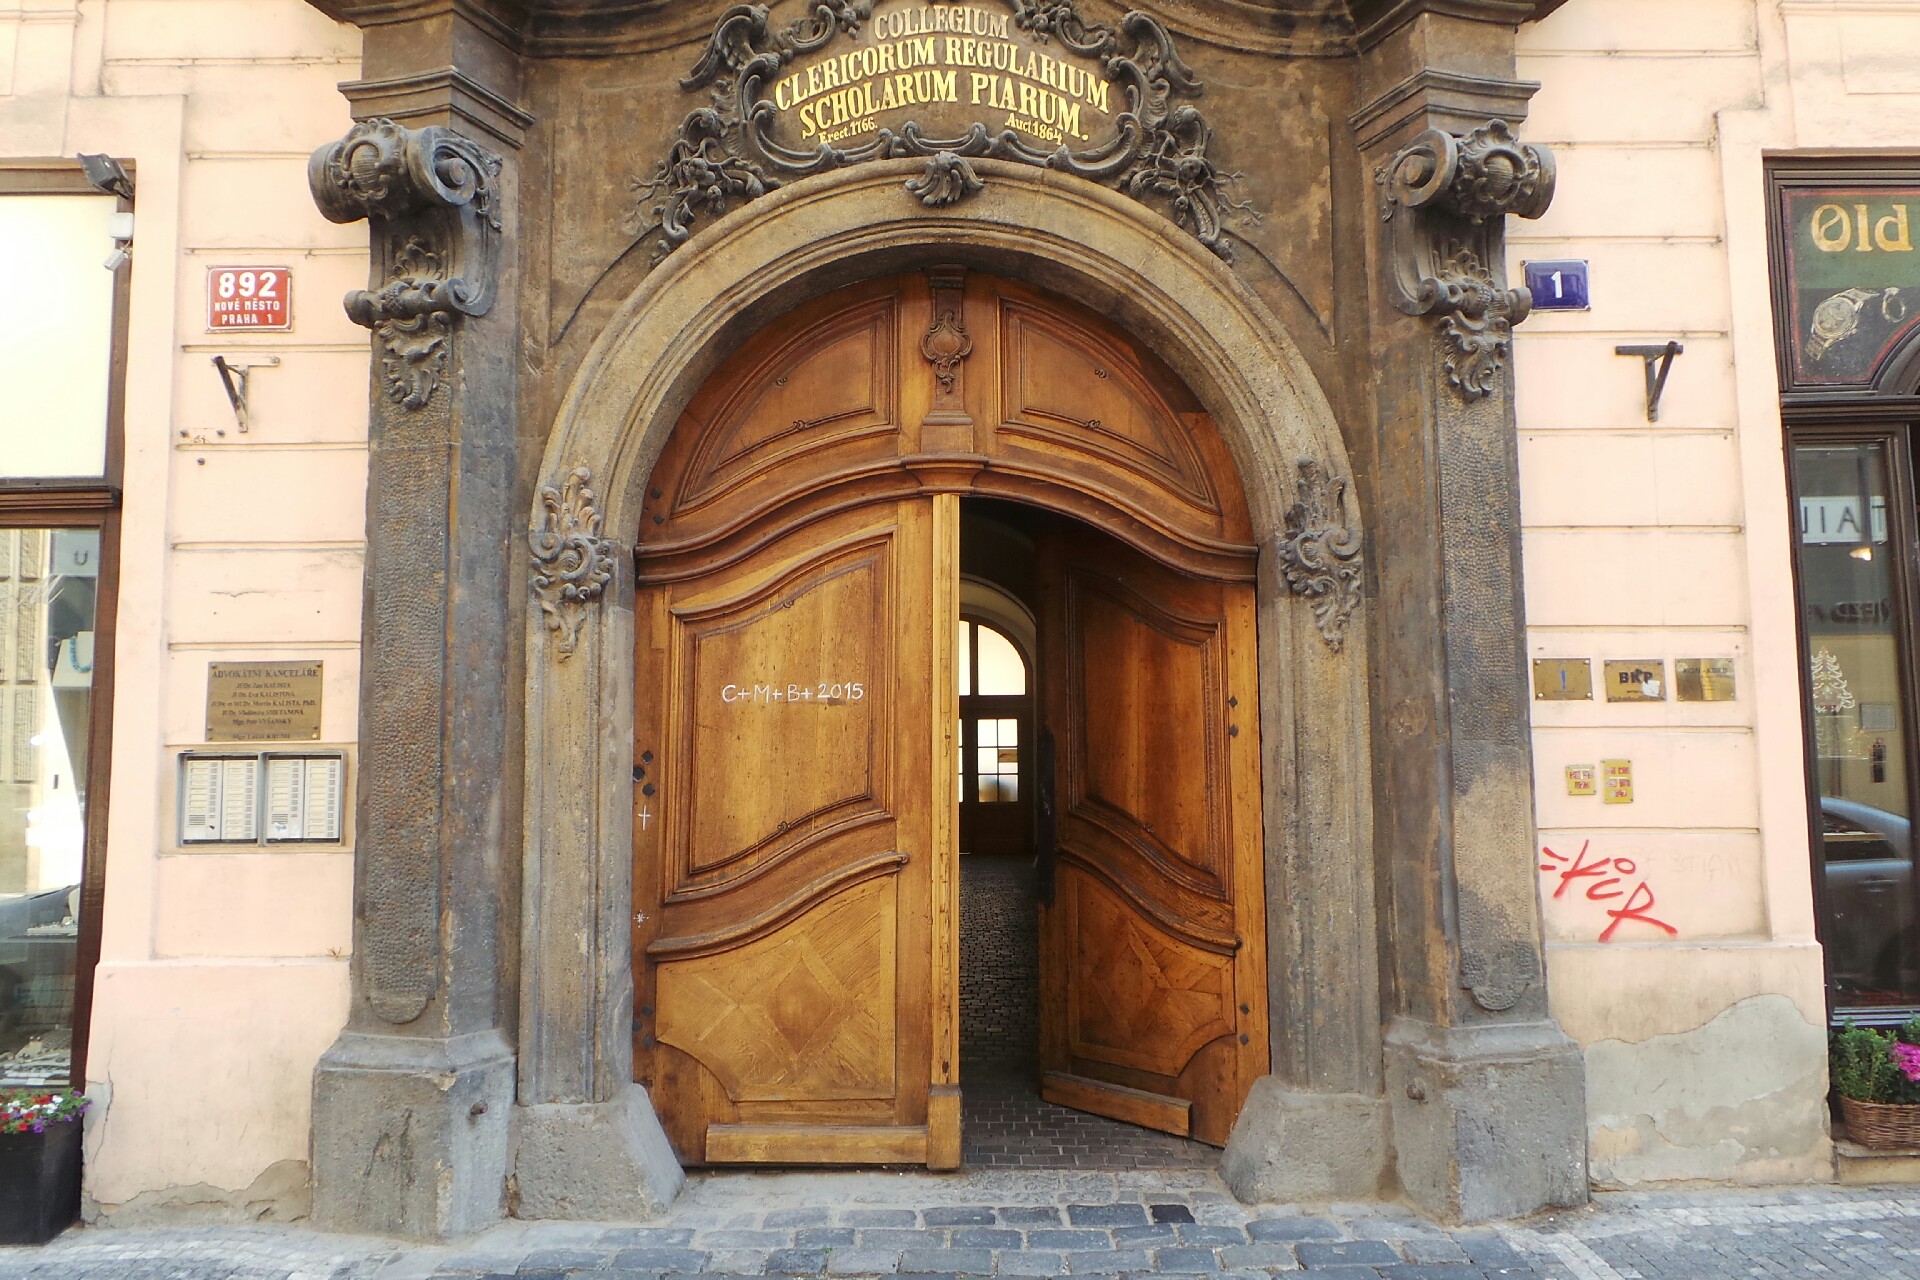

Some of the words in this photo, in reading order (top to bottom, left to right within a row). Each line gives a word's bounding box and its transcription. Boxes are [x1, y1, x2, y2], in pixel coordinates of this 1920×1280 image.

[874, 5, 1008, 39] COLLEGIUM
[775, 37, 937, 111] CLERICORUM
[945, 37, 1110, 114] REGULARIUM
[799, 70, 957, 140] SCHOLARUM
[970, 72, 1089, 141] PIARUM.
[1811, 203, 1914, 252] Old
[219, 271, 277, 298] 892
[1551, 271, 1562, 298] 1
[214, 298, 241, 311] NOVÉ
[244, 298, 281, 311] MĚSTO
[221, 314, 259, 325] PRAHA
[267, 314, 273, 324] 1
